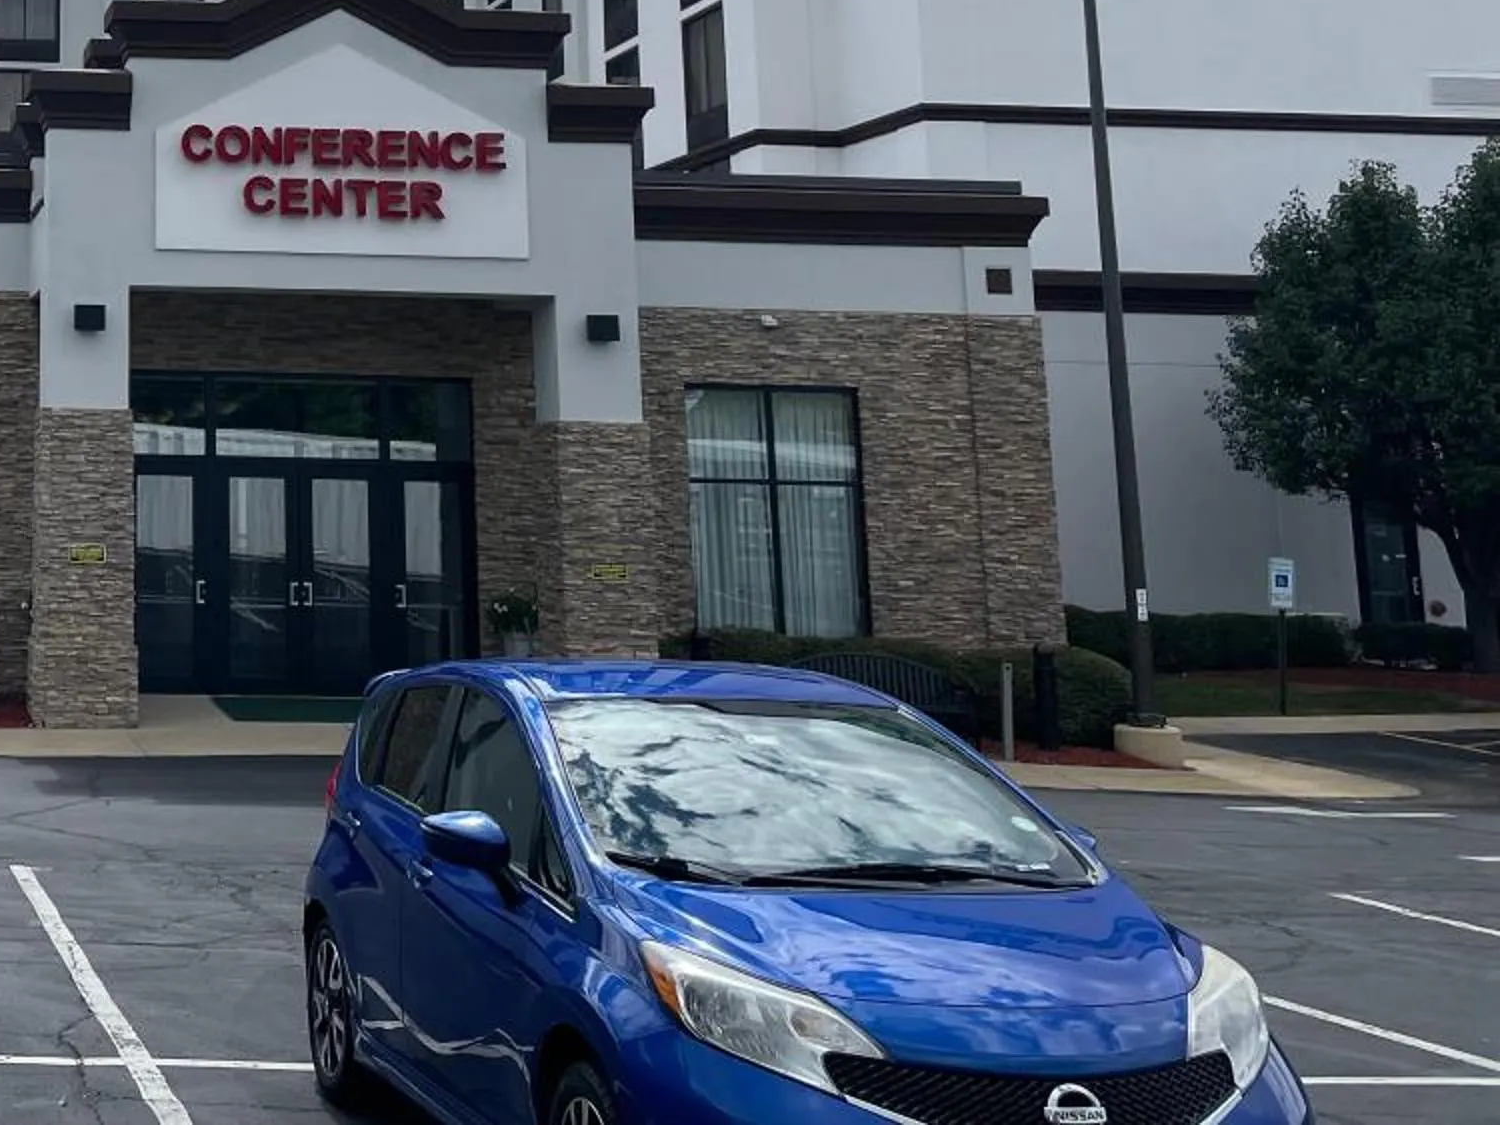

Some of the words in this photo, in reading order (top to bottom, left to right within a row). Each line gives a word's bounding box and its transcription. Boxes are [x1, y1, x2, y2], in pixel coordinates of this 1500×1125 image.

[181, 124, 507, 172] CONFERENCE
[243, 175, 445, 221] CENTER
[1052, 1110, 1104, 1121] NISSAN
